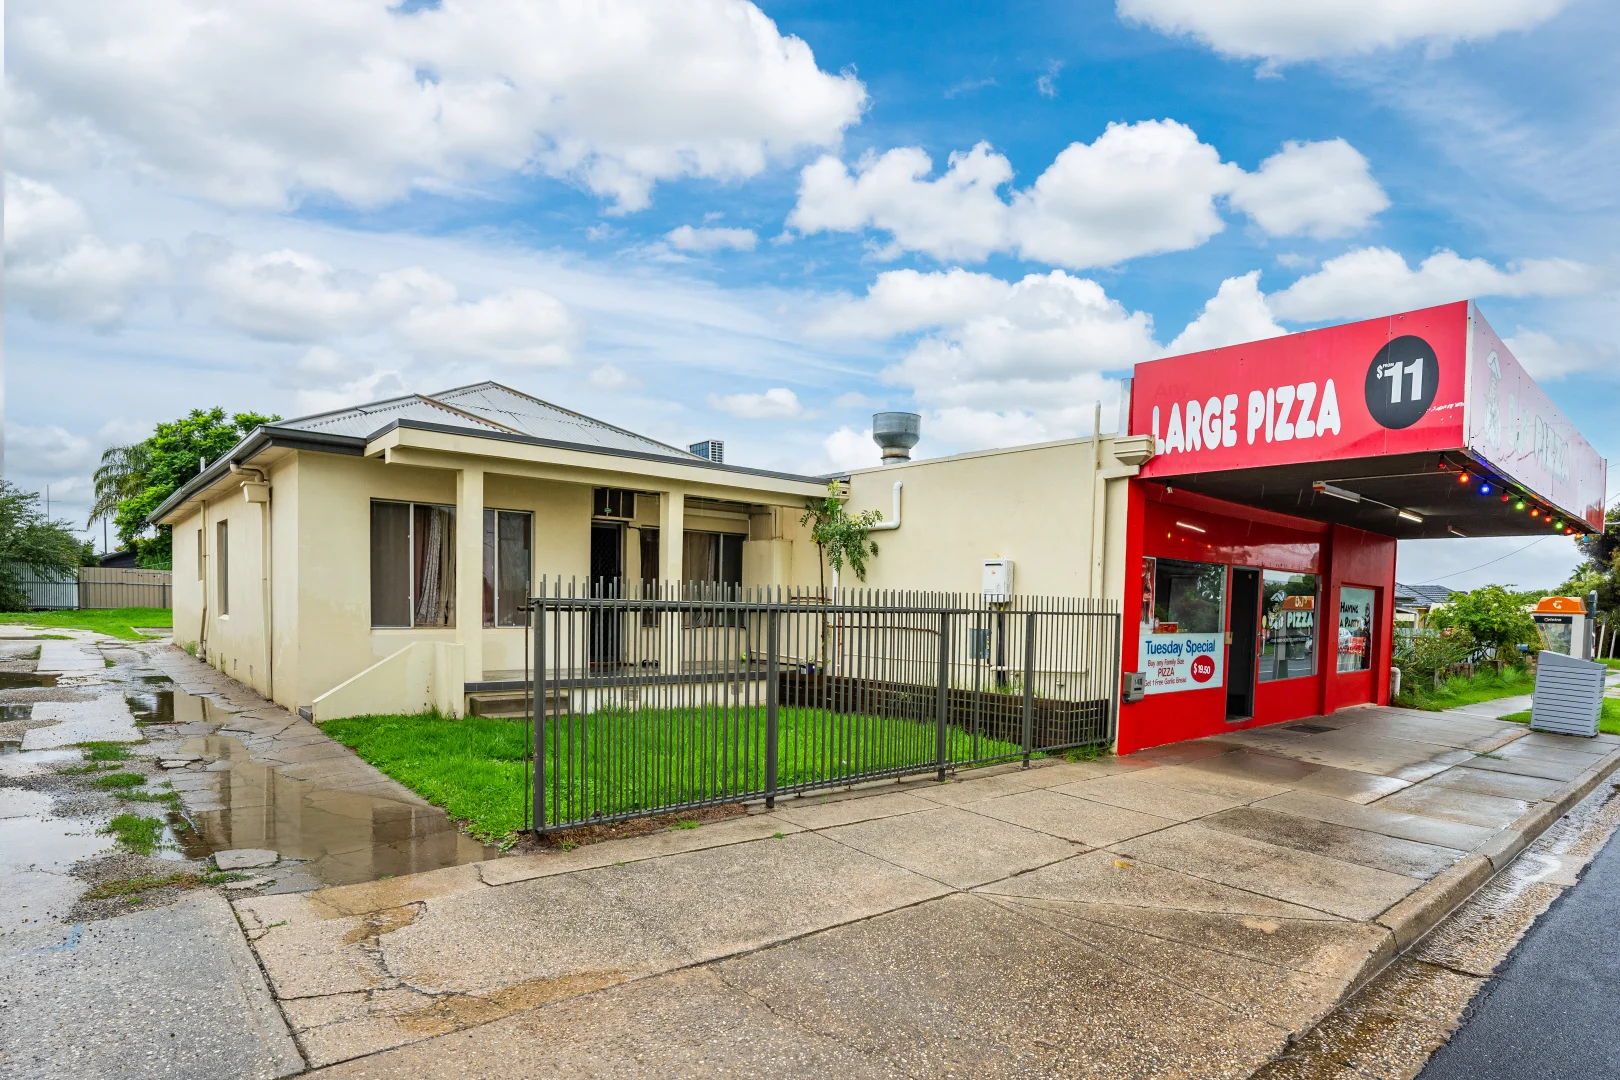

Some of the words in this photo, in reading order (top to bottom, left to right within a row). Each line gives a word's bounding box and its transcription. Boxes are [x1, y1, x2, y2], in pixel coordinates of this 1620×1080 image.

[1152, 396, 1239, 456] LARGE
[1247, 378, 1342, 446] PIZZA
[1287, 611, 1314, 628] PIZZA
[1145, 641, 1183, 657] Tuesday
[1186, 640, 1215, 656] Special
[1157, 667, 1175, 677] PIZZA
[1164, 677, 1175, 685] Garlic
